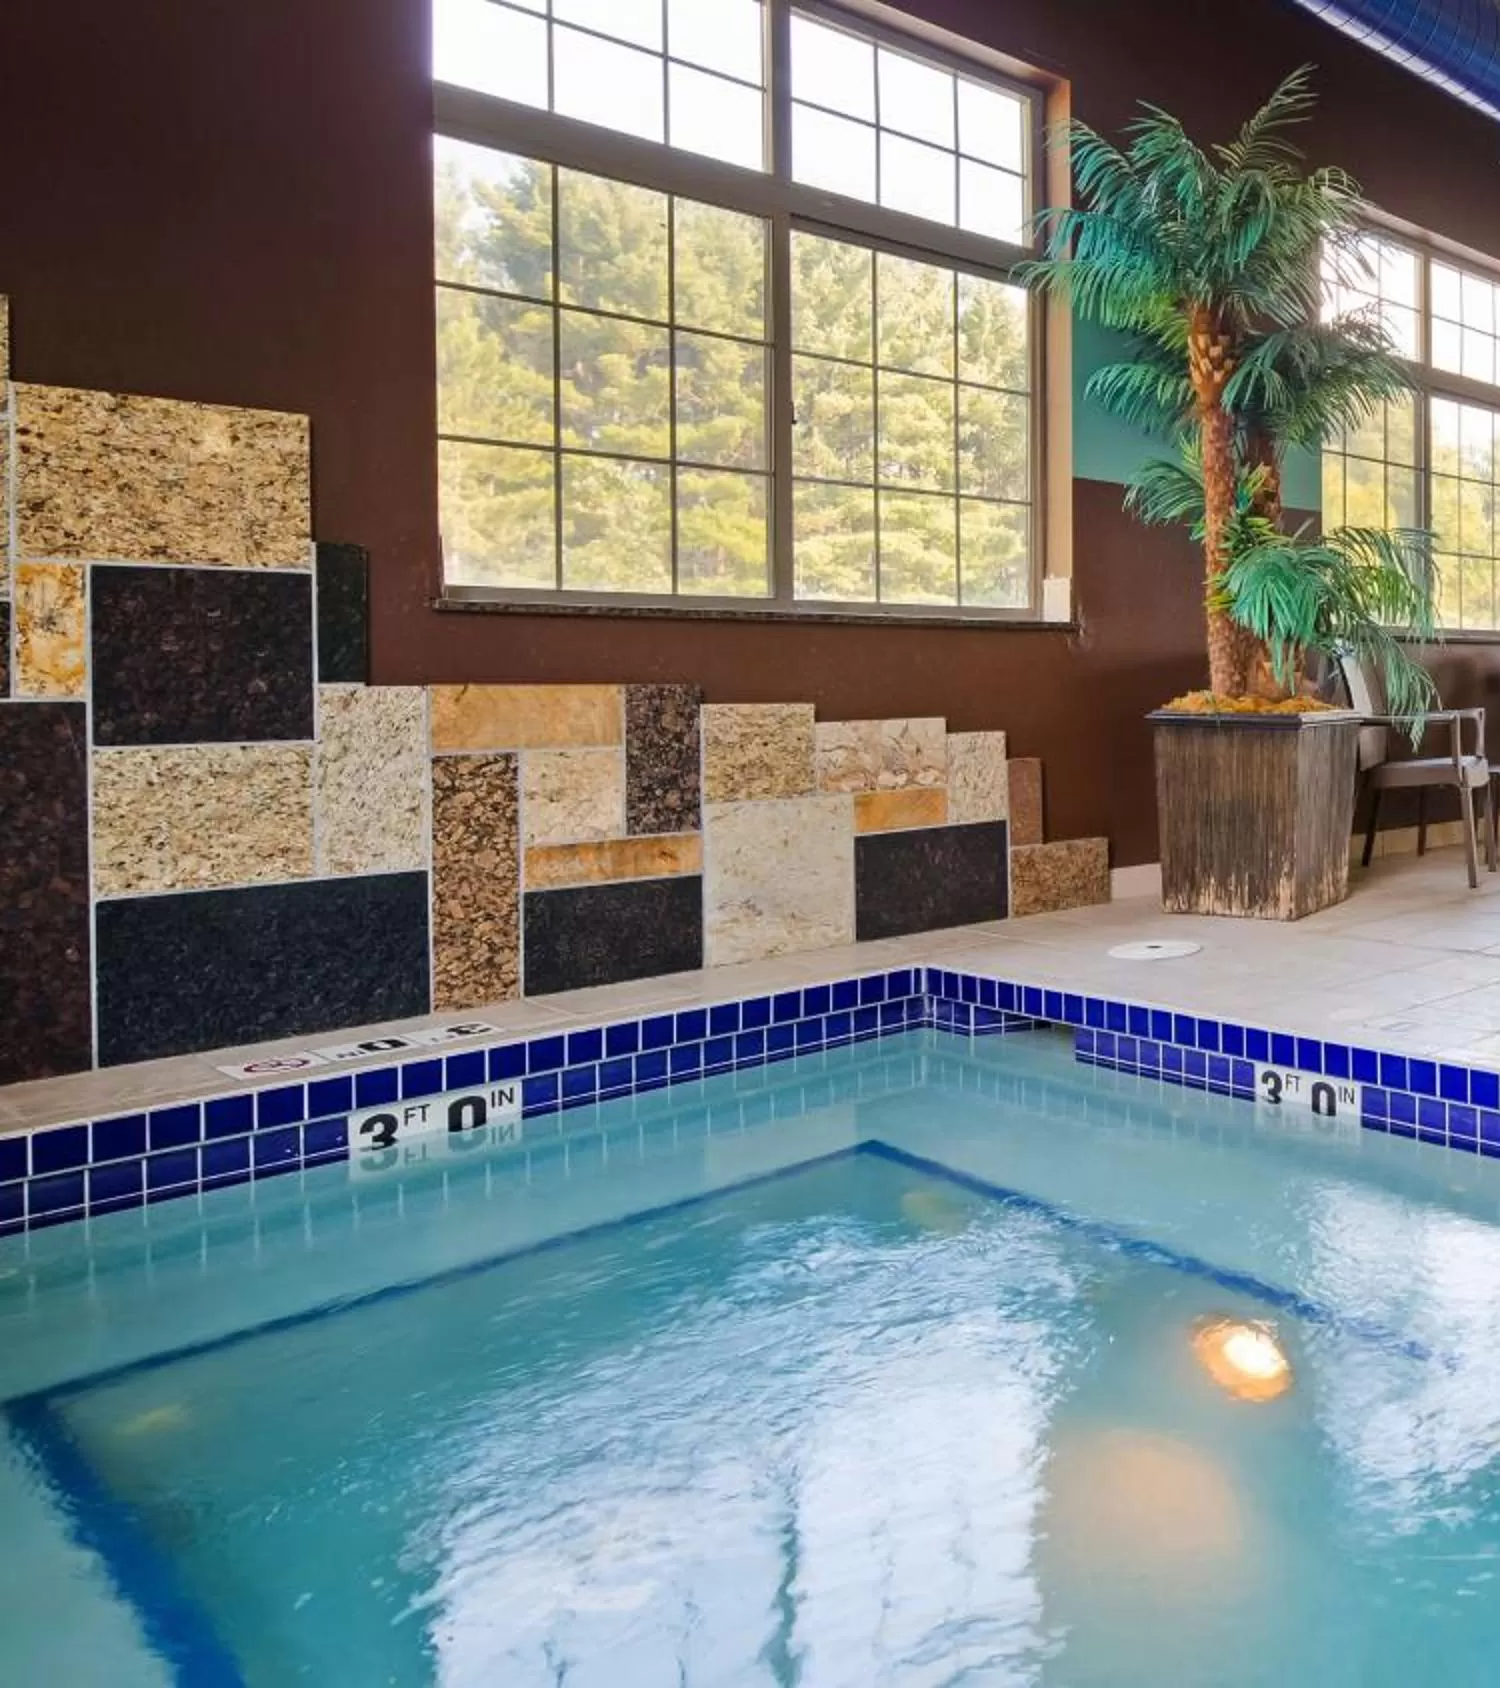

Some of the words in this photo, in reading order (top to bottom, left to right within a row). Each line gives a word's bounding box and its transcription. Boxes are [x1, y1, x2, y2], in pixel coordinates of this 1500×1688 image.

[1261, 1070, 1282, 1104] 3
[1286, 1074, 1301, 1092] FT
[1338, 1086, 1356, 1105] IN
[360, 1113, 399, 1151] 3
[403, 1103, 431, 1127] FT
[448, 1095, 488, 1132] 0
[490, 1087, 515, 1109] IN
